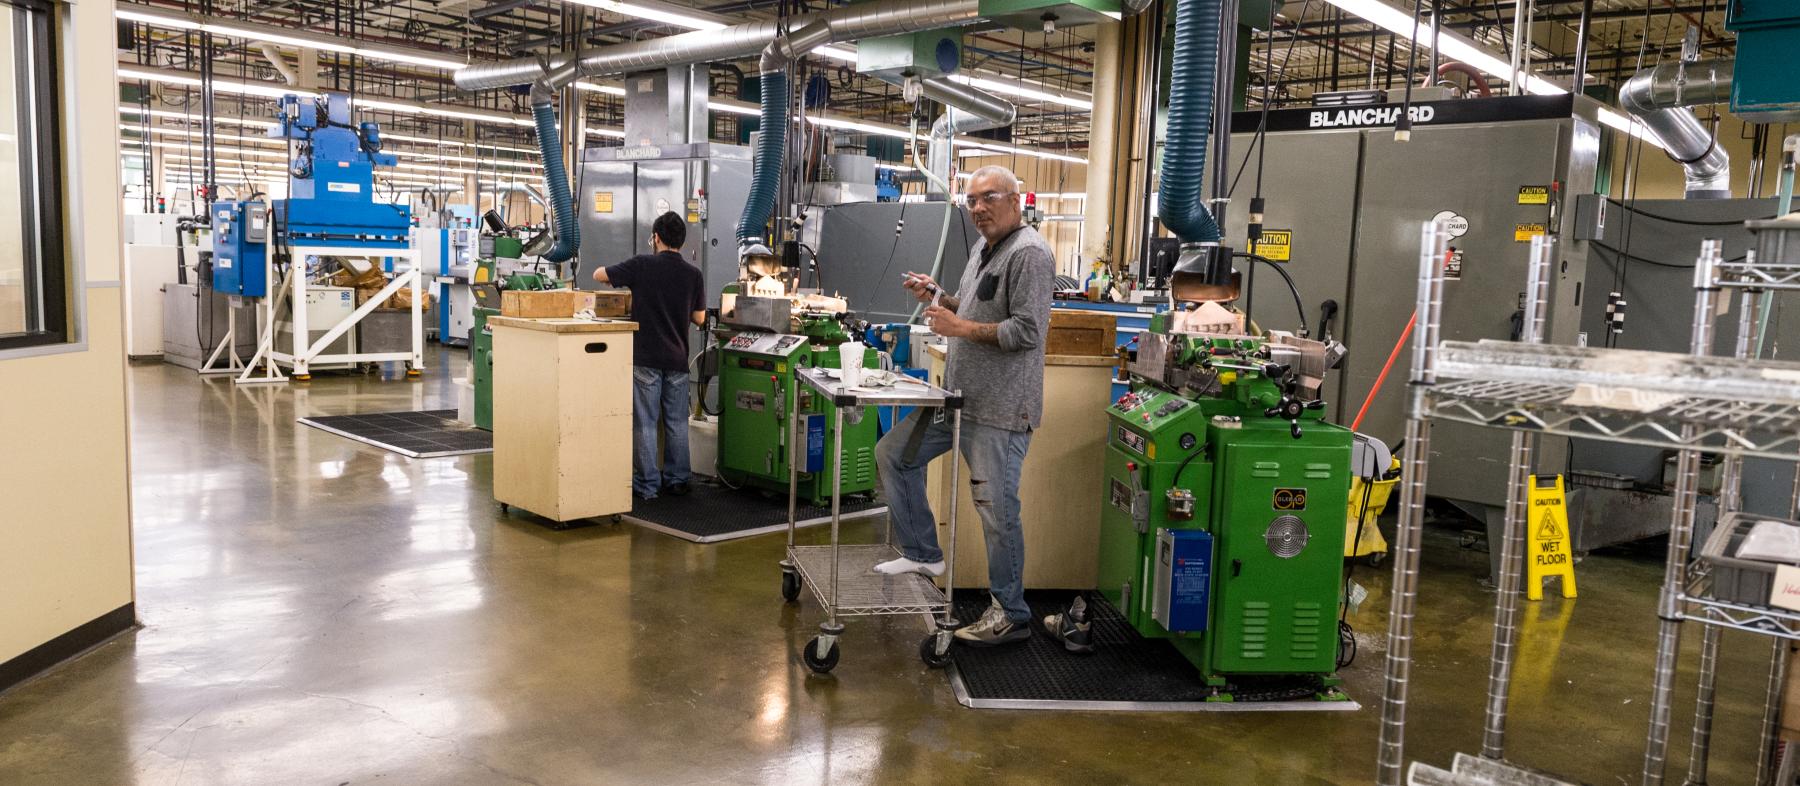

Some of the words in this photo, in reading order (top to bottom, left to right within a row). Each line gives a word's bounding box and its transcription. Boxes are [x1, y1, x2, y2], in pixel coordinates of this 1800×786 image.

[616, 147, 661, 159] BLANCHARD
[1256, 234, 1287, 244] AUTION
[1541, 542, 1560, 552] WET
[1537, 554, 1566, 565] FLOOR
